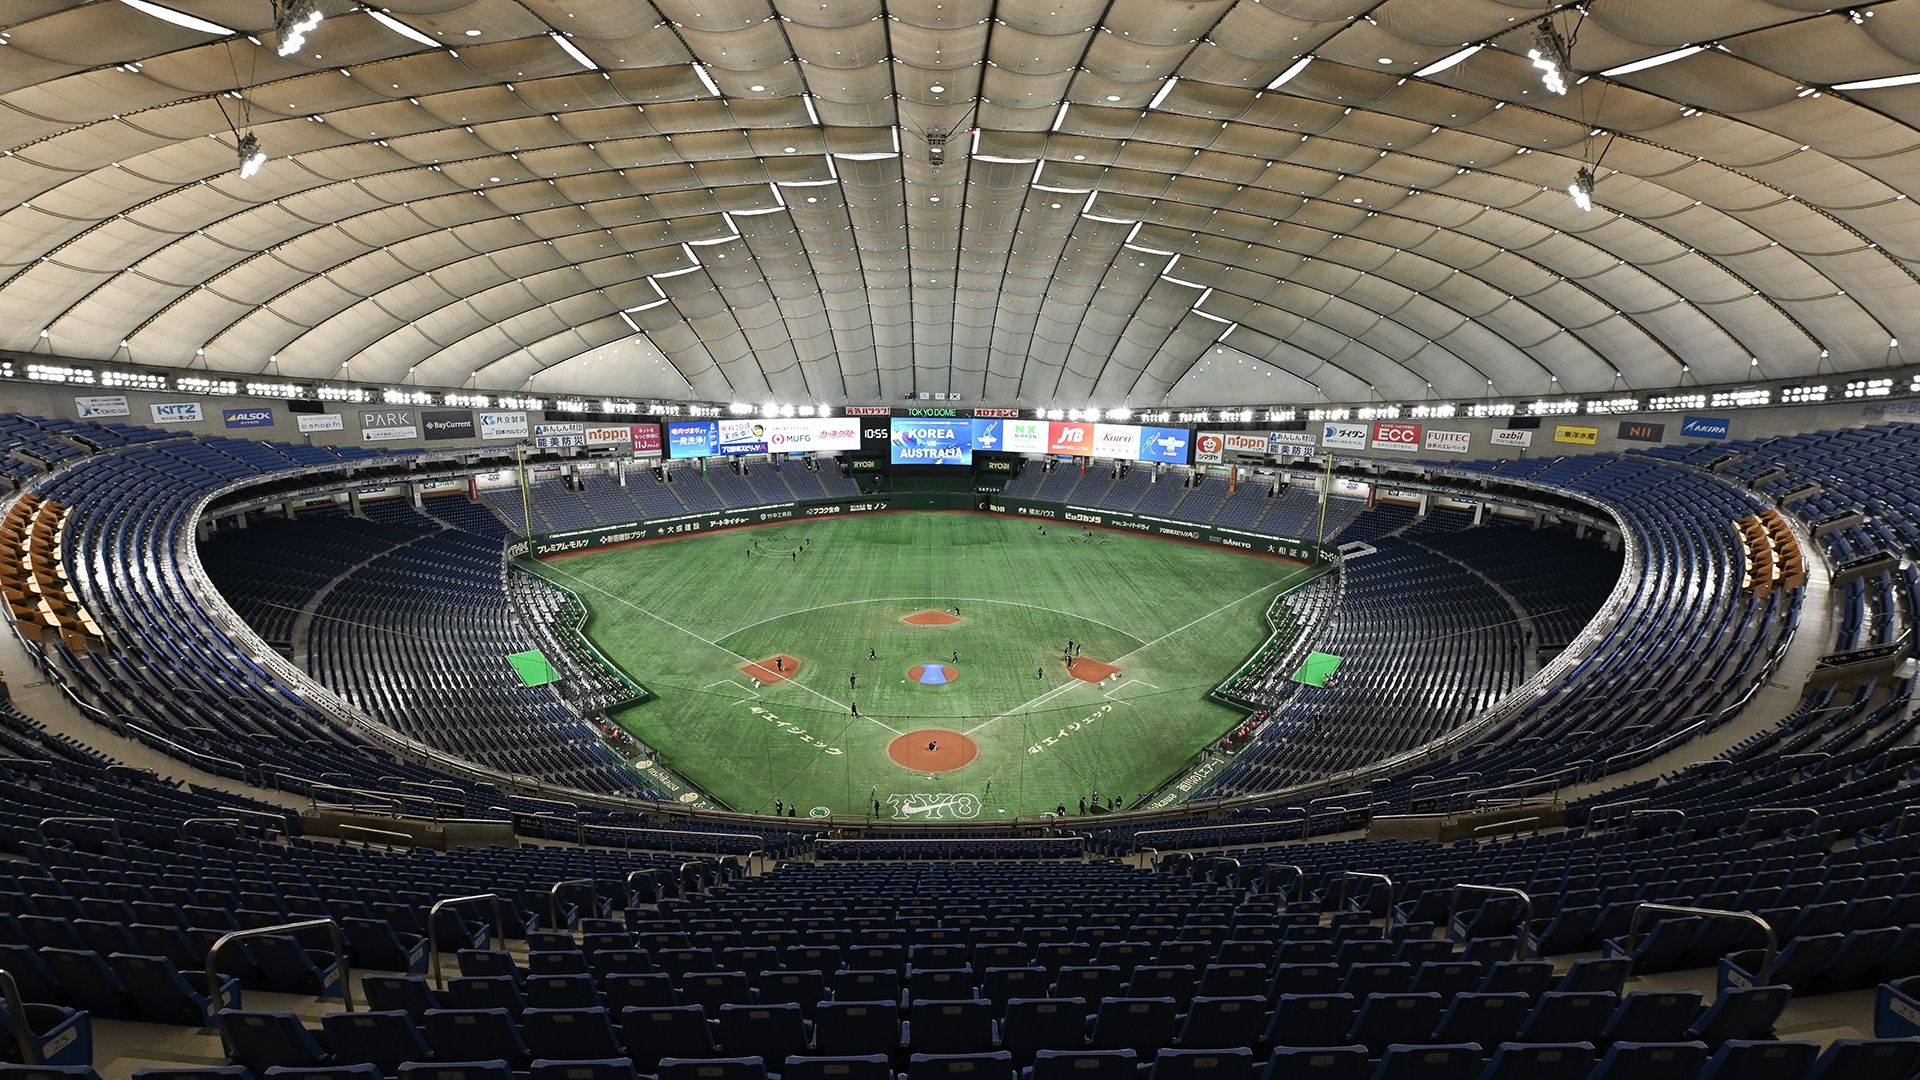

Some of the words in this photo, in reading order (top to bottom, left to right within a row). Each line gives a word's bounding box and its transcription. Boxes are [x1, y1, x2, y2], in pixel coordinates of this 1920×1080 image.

[157, 404, 196, 415] KITZ
[908, 408, 933, 416] TOKYO
[934, 408, 956, 416] DOME
[975, 409, 1018, 417] オロナミンC
[237, 412, 270, 420] ALSOK
[365, 412, 410, 427] PARK
[496, 415, 526, 423] 共立製薬
[434, 420, 472, 430] BayCurrent
[543, 424, 583, 433] あんしん財団
[1015, 425, 1036, 433] NX
[1694, 424, 1726, 433] AKIRA
[588, 428, 629, 440] nippn
[864, 428, 888, 438] 10:55
[908, 428, 956, 439] KOREA
[1057, 426, 1085, 444] JTB
[1277, 433, 1315, 443] あんしん財団
[1339, 429, 1366, 438] ダイダン
[1378, 428, 1414, 442] ECC
[1428, 432, 1470, 443] FUJITEC
[1499, 431, 1524, 440] azbil
[1563, 430, 1596, 440] 東洋水産
[537, 436, 583, 447] 能美防災
[1227, 436, 1265, 449] nippn
[900, 447, 963, 458] AUSTRALIA
[1269, 444, 1313, 456] 能美防災
[988, 462, 1010, 470] RYOBI
[667, 522, 701, 534] 大成建設
[710, 517, 750, 528] アートネイチャー
[1222, 538, 1252, 549] SANKYO
[1267, 544, 1309, 559] 大和証券
